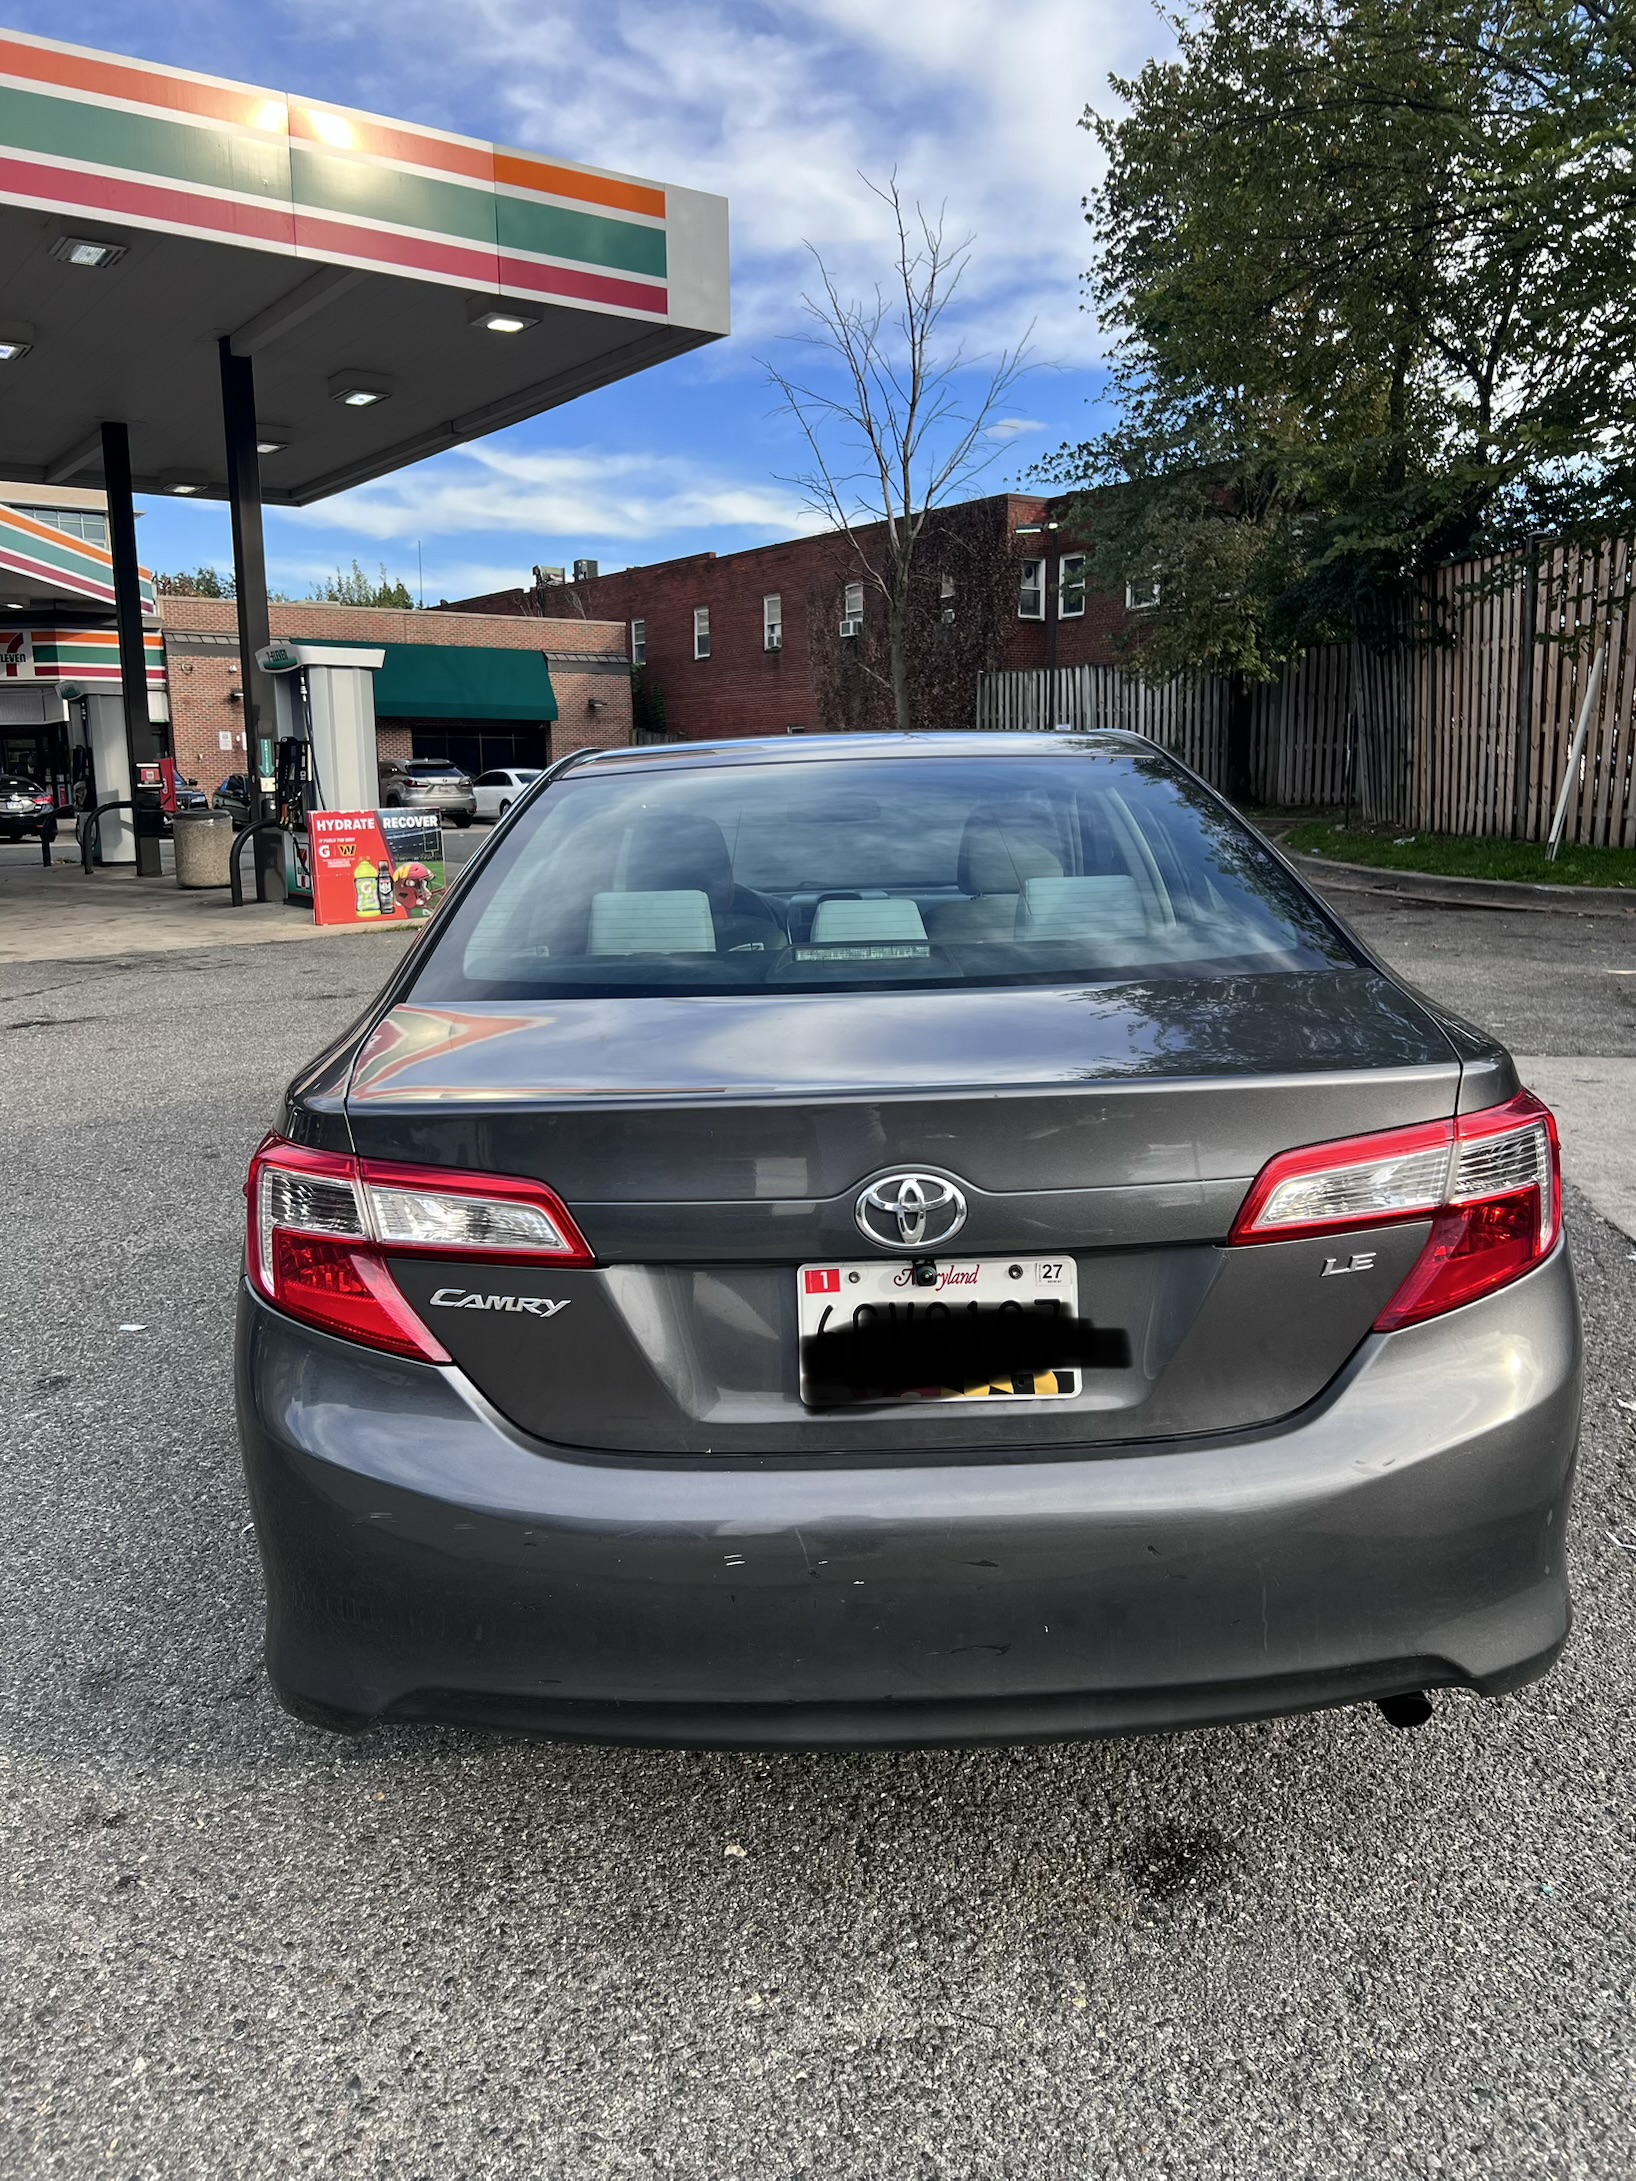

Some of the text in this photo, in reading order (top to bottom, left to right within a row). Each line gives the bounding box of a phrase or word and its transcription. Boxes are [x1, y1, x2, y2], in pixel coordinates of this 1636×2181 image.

[266, 649, 289, 663] 7-ELEVEN
[316, 815, 438, 832] HYDRATE RECOVER
[318, 844, 331, 858] G
[1042, 1264, 1063, 1279] 27
[1320, 1252, 1377, 1277] LE
[819, 1271, 829, 1290] 1
[893, 1264, 981, 1292] Mryland
[429, 1288, 572, 1318] CAMRY
